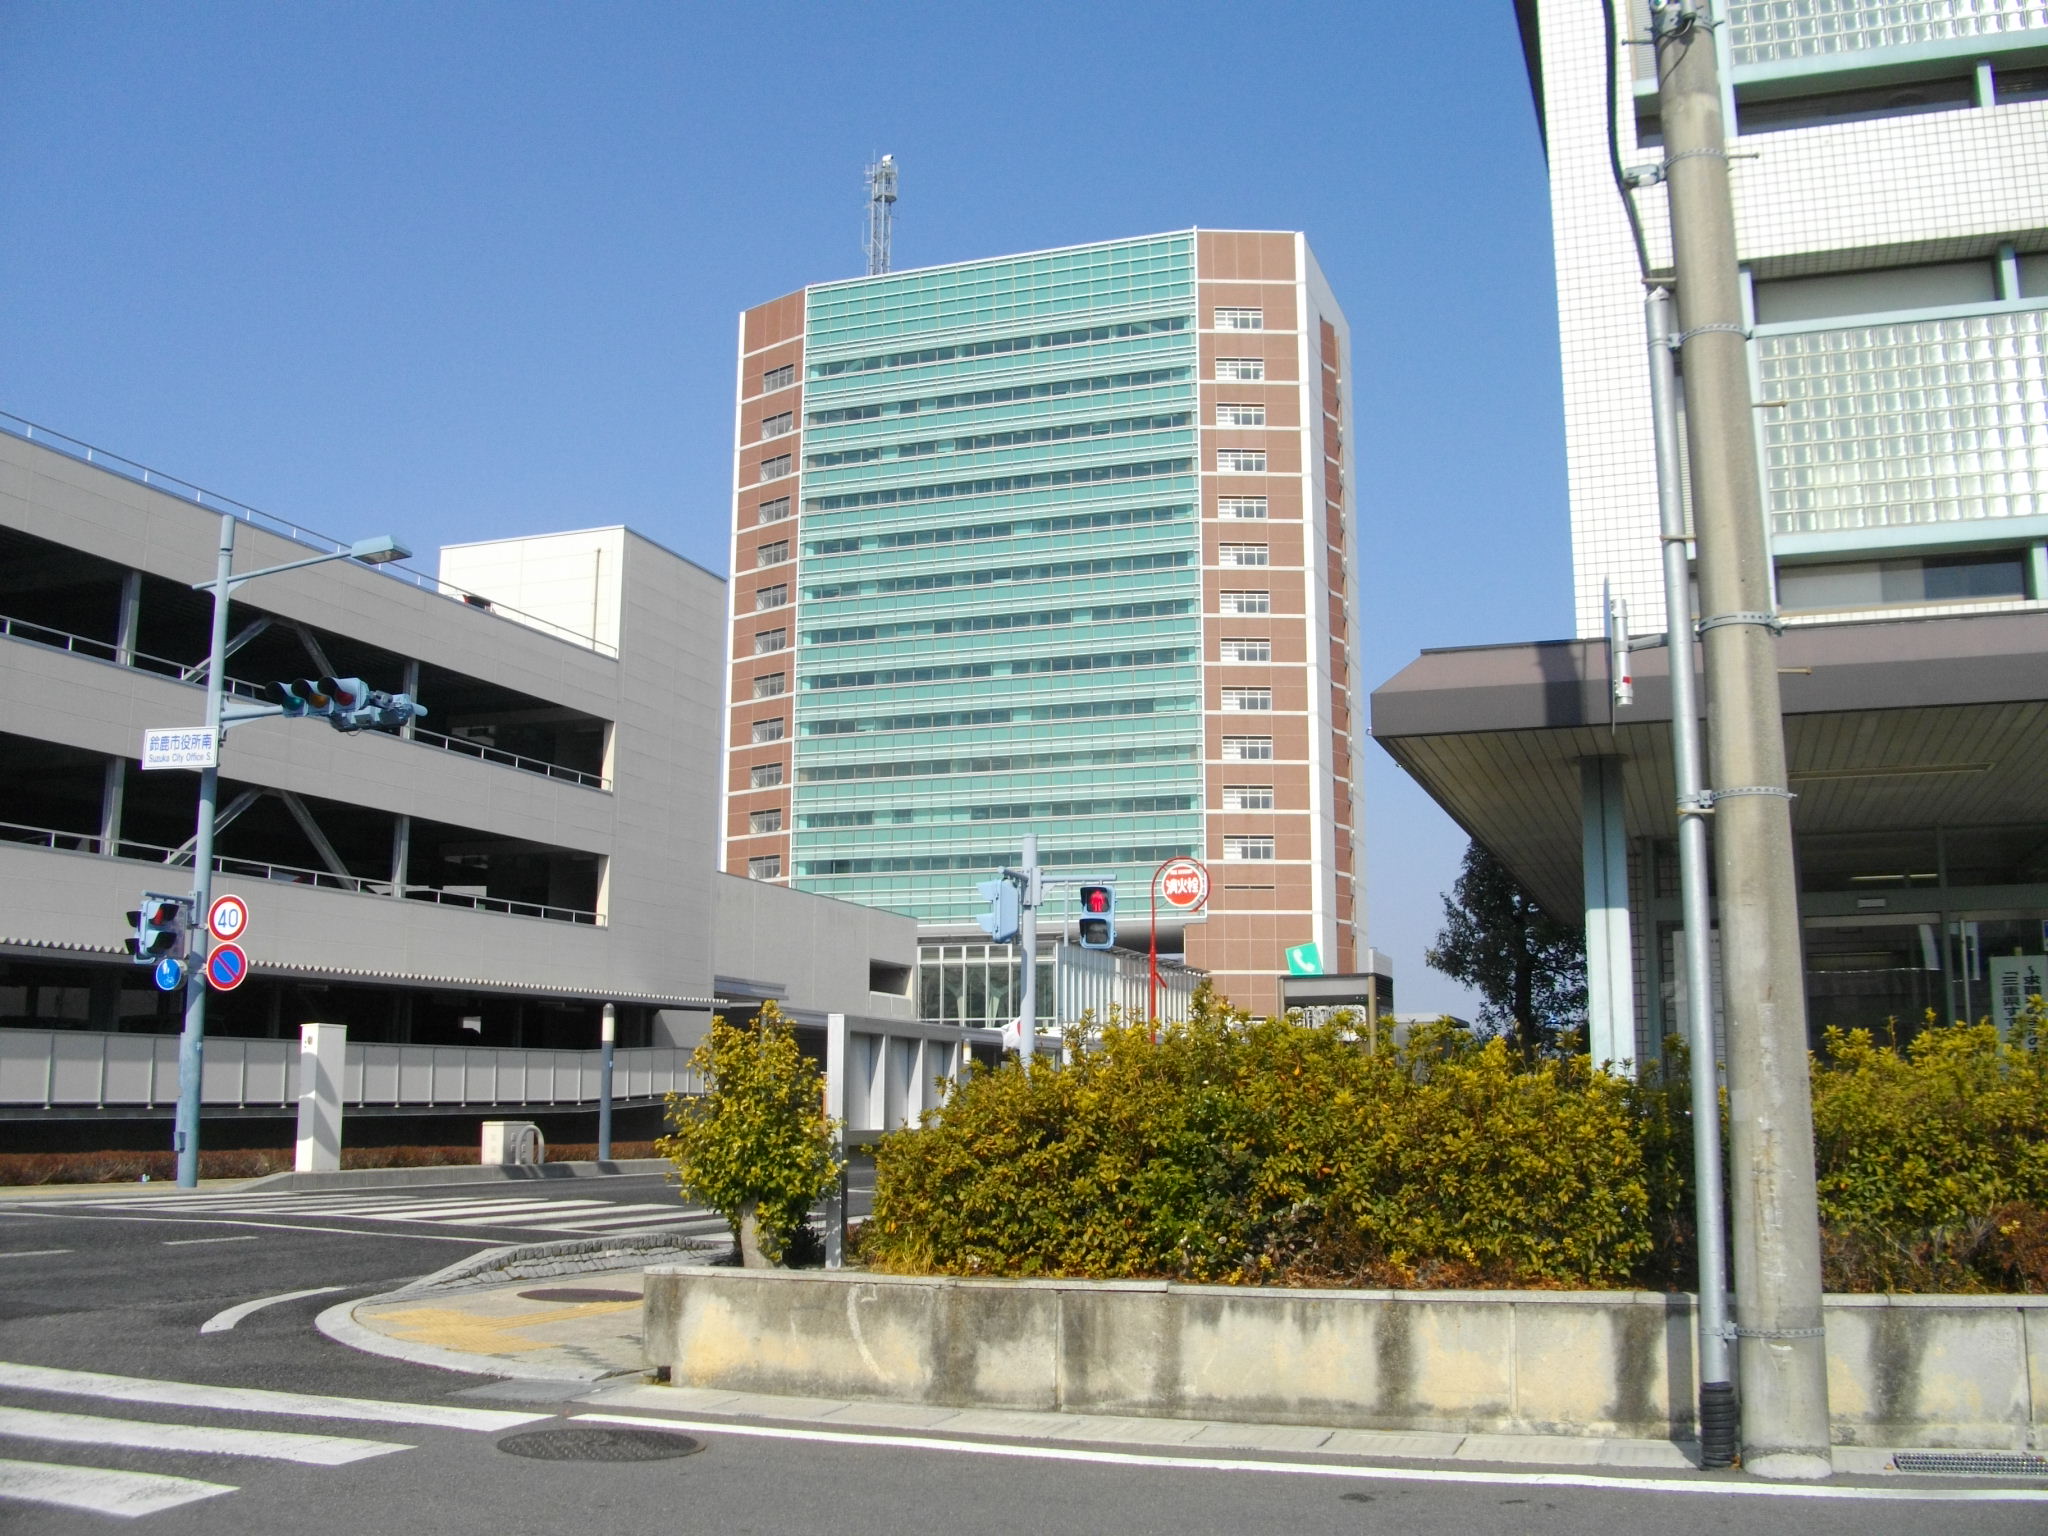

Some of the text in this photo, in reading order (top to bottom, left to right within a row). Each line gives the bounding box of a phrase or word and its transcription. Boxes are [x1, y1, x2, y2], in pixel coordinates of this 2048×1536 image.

[149, 734, 212, 752] 鈴鹿市役所南
[172, 753, 184, 763] City
[186, 752, 204, 762] Office
[1165, 876, 1199, 895] 消火栓
[217, 908, 239, 928] 40
